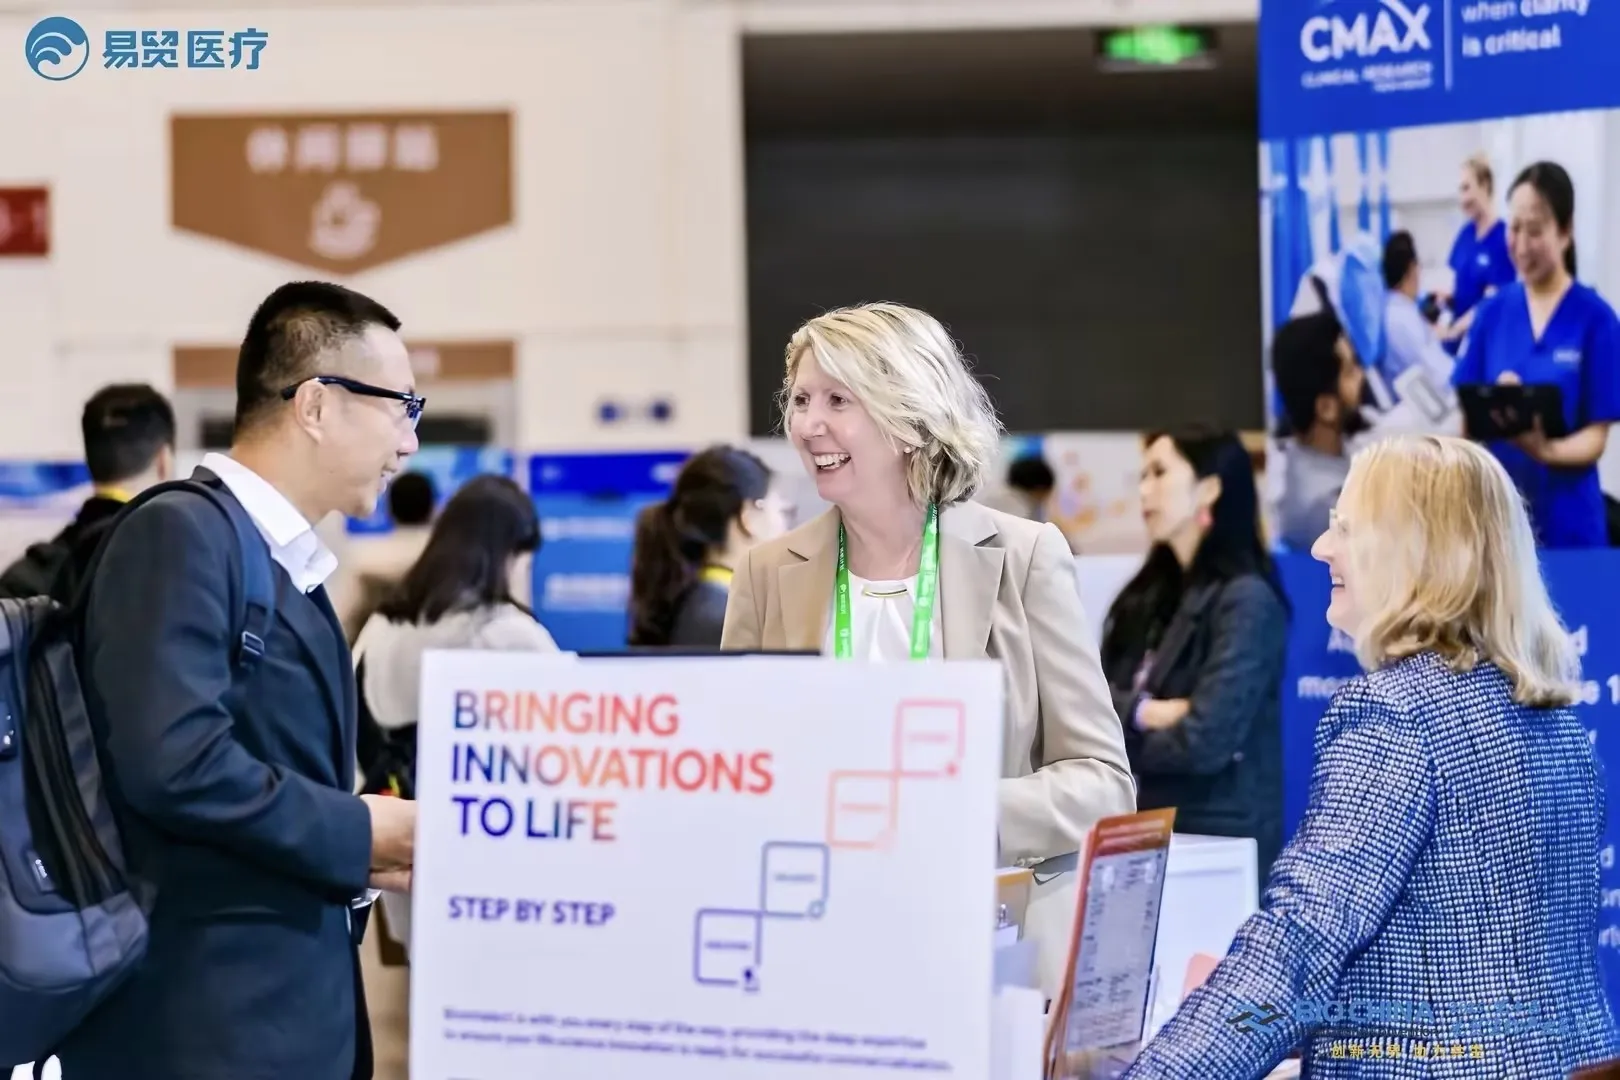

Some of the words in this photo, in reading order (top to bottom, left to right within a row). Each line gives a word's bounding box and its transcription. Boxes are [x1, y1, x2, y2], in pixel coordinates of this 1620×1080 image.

[1300, 2, 1430, 62] CMAX
[454, 690, 680, 737] BRINGING
[451, 743, 774, 795] INNOVATIONS
[451, 797, 514, 838] TO
[526, 800, 618, 841] LIFE
[448, 896, 510, 921] STEP
[516, 899, 546, 923] BY
[553, 901, 617, 926] STEP
